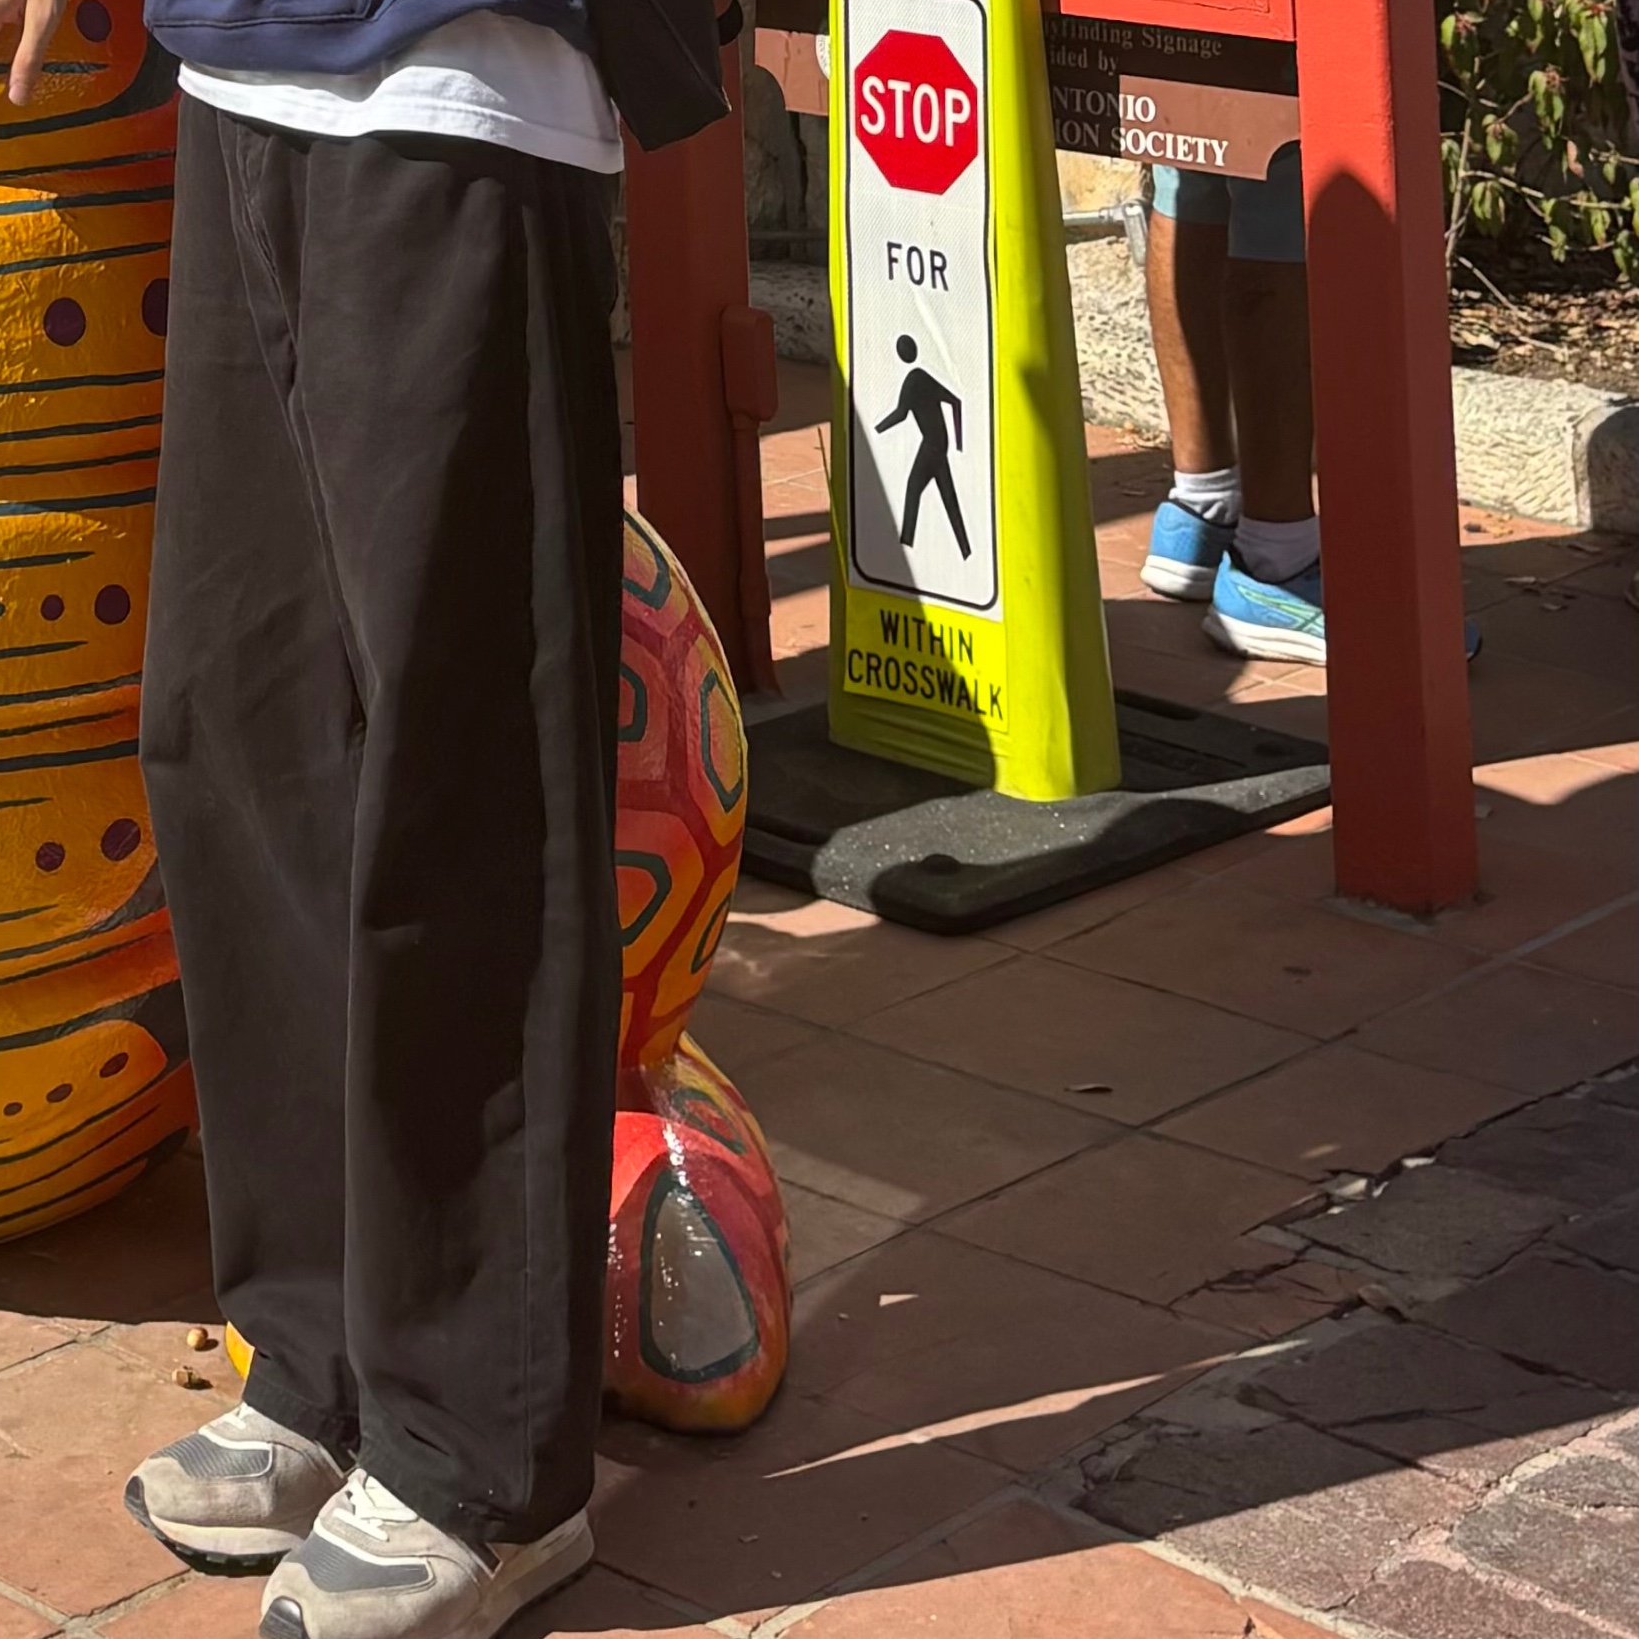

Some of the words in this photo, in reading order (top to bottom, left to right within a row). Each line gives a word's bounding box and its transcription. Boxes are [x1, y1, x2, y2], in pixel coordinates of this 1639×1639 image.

[1098, 49, 1118, 75] by
[1142, 27, 1223, 59] Signage
[860, 76, 970, 147] STOP
[1111, 126, 1229, 166] SOCIETY
[886, 241, 949, 292] FOR
[880, 609, 973, 665] WITHIN
[848, 649, 1003, 722] CROSSWALK
